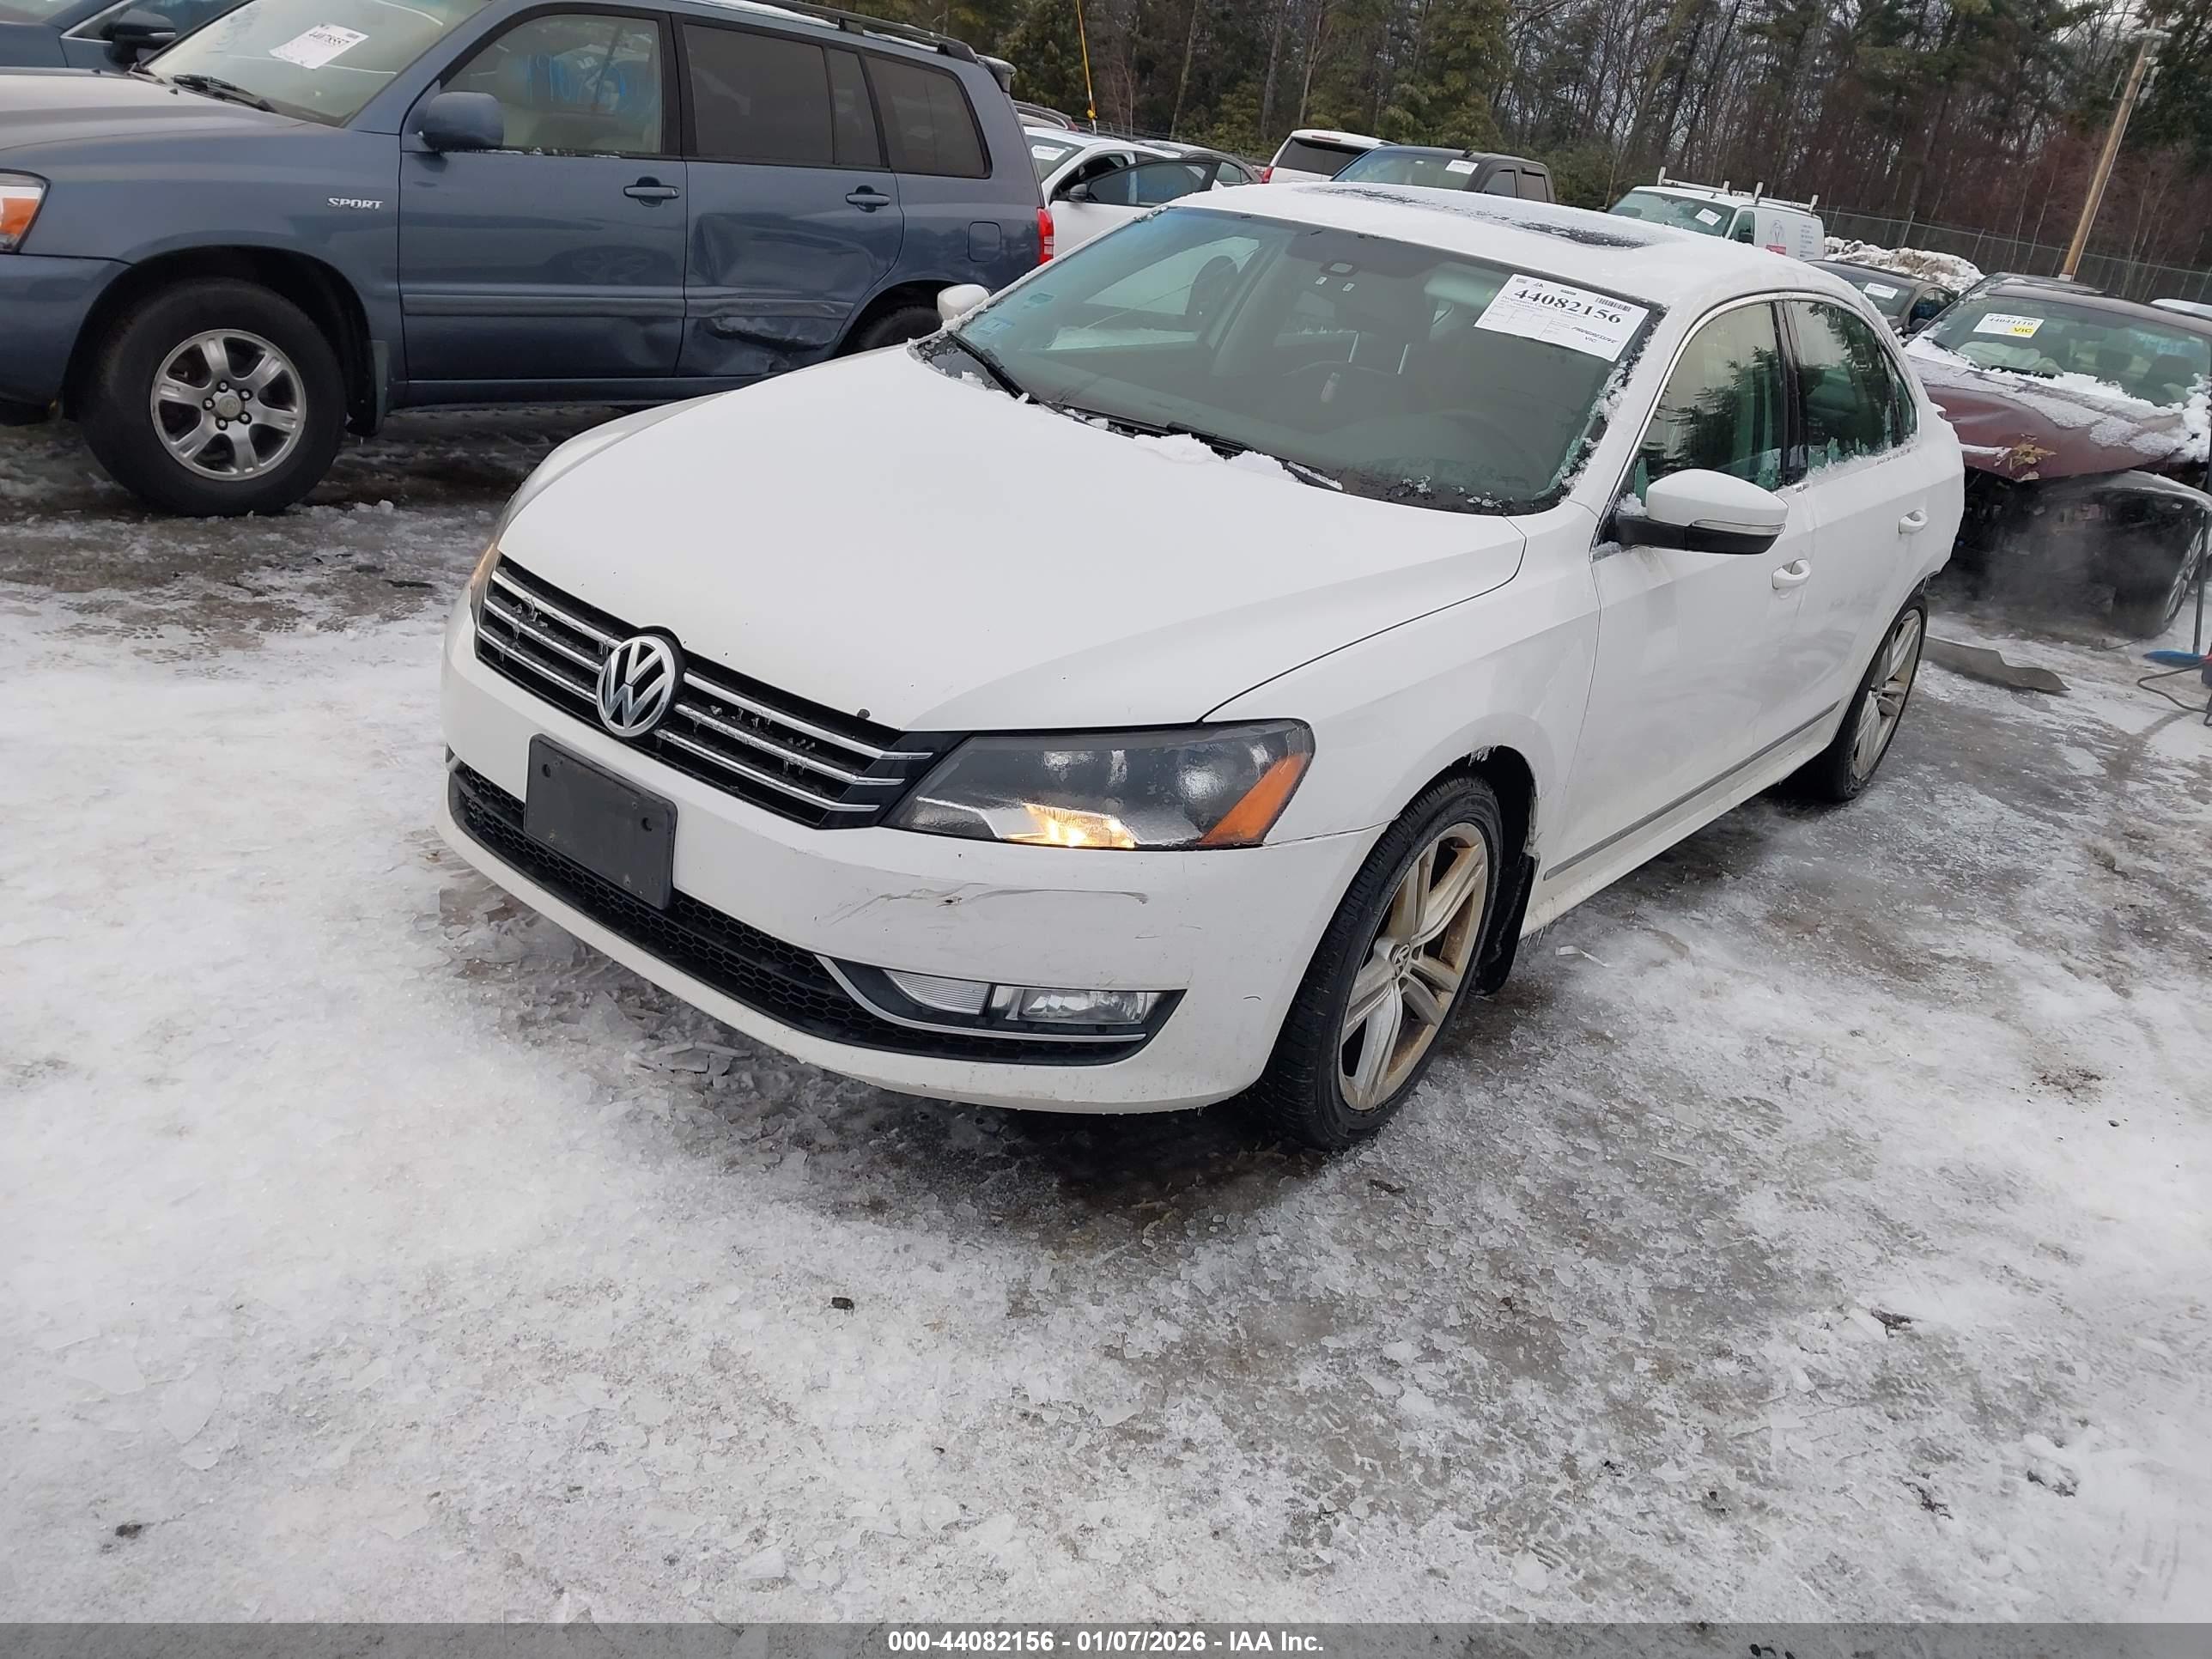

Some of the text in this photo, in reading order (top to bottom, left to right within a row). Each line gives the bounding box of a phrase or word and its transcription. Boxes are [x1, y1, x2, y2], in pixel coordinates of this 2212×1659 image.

[327, 198, 384, 210] SPORT
[1515, 289, 1620, 324] 44082156
[598, 636, 674, 736] VW
